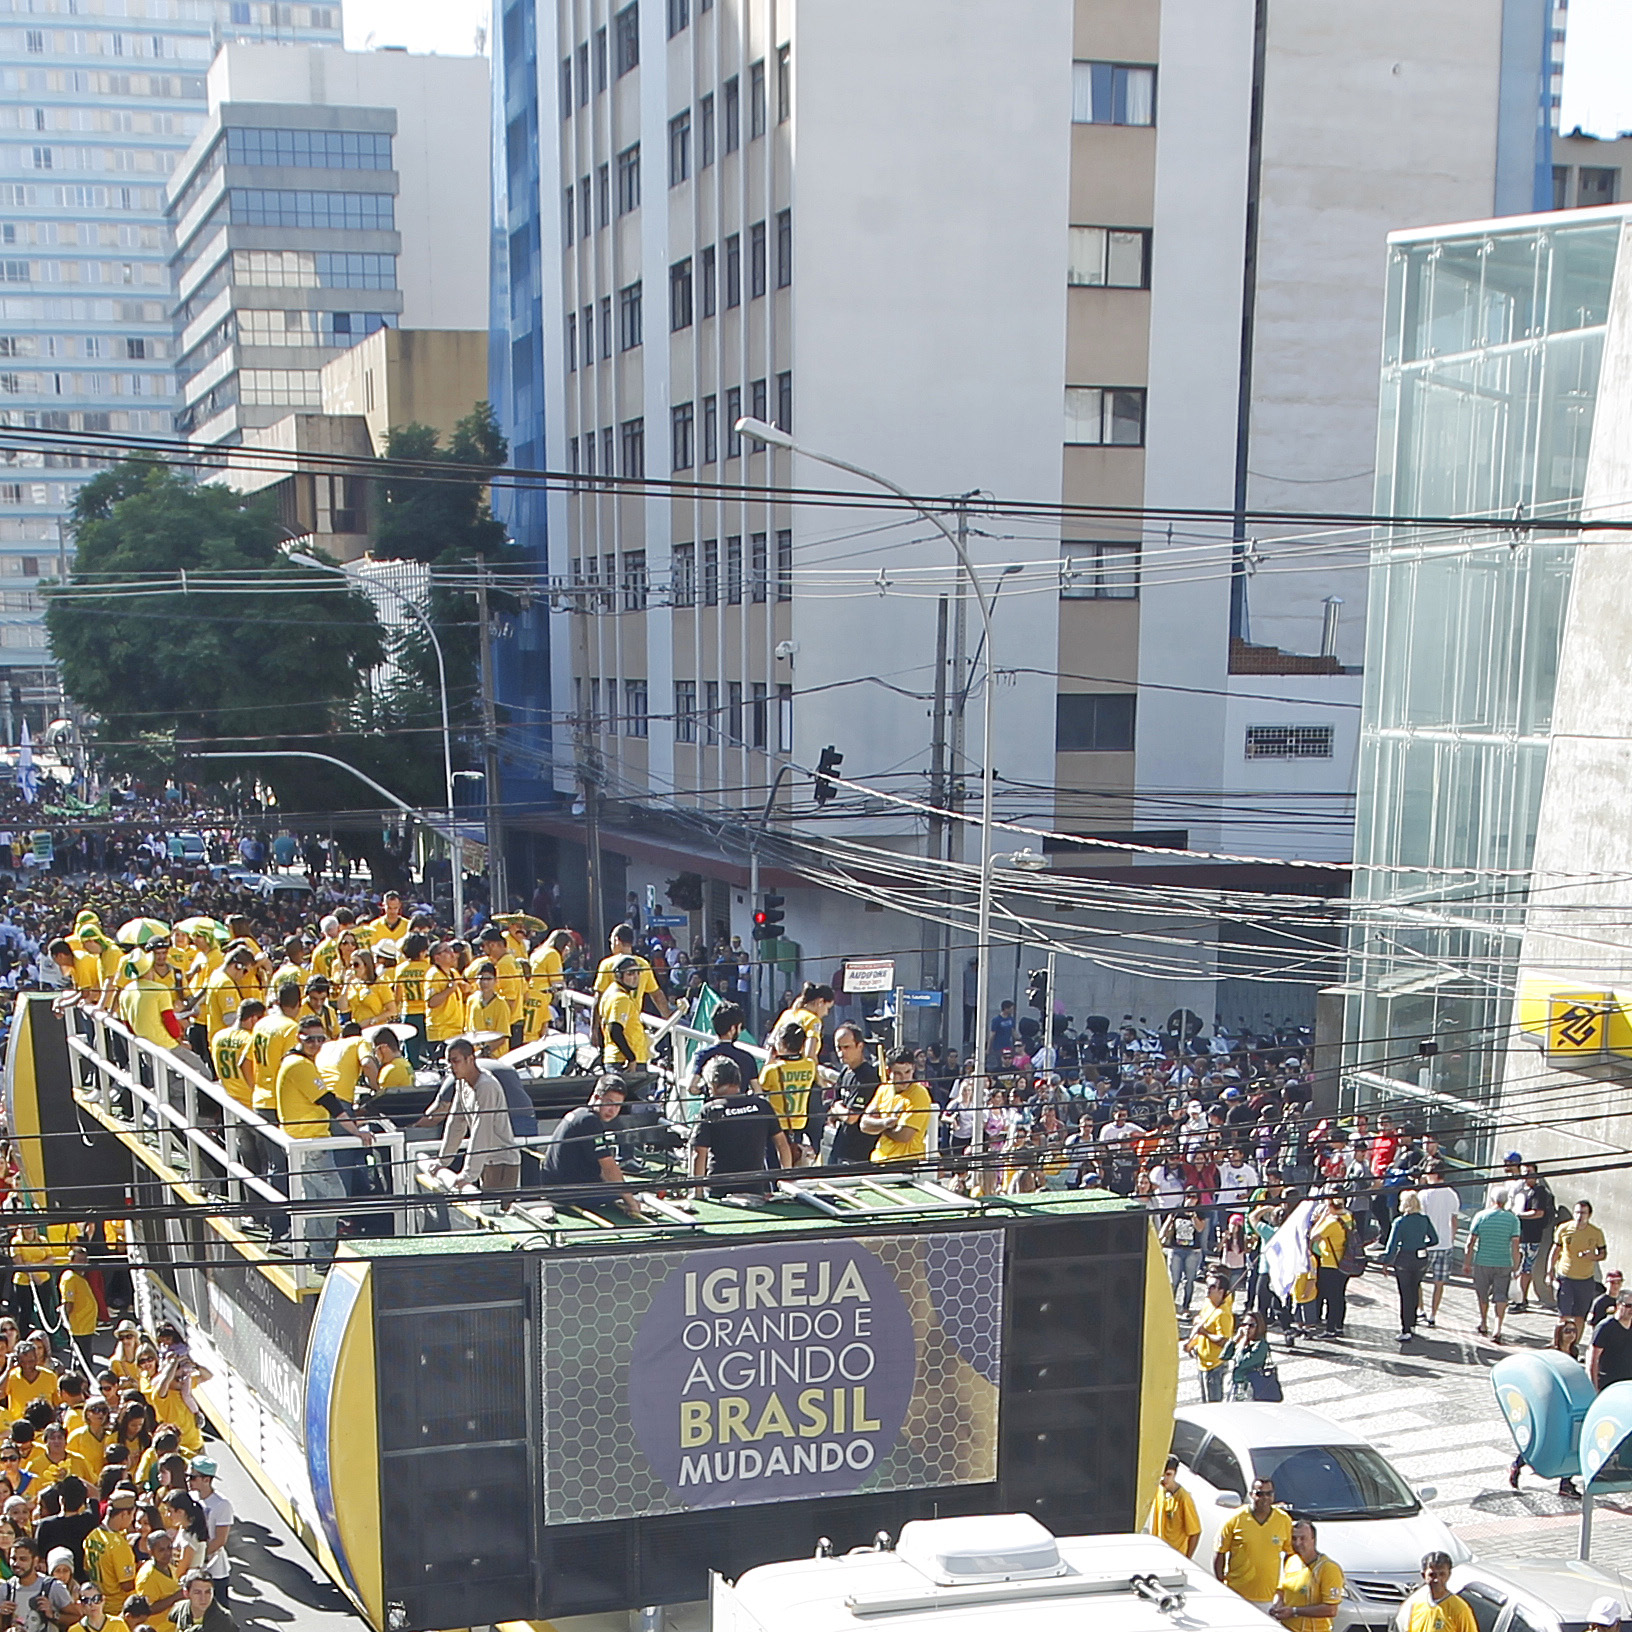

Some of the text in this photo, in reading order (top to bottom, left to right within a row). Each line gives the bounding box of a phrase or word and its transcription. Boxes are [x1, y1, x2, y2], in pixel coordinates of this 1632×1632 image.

[684, 1259, 872, 1317] IGREJA
[682, 1307, 872, 1351] ORANDO E
[681, 1342, 877, 1396] AGINDO
[680, 1385, 882, 1449] BRASIL
[678, 1438, 876, 1487] MUDANDO
